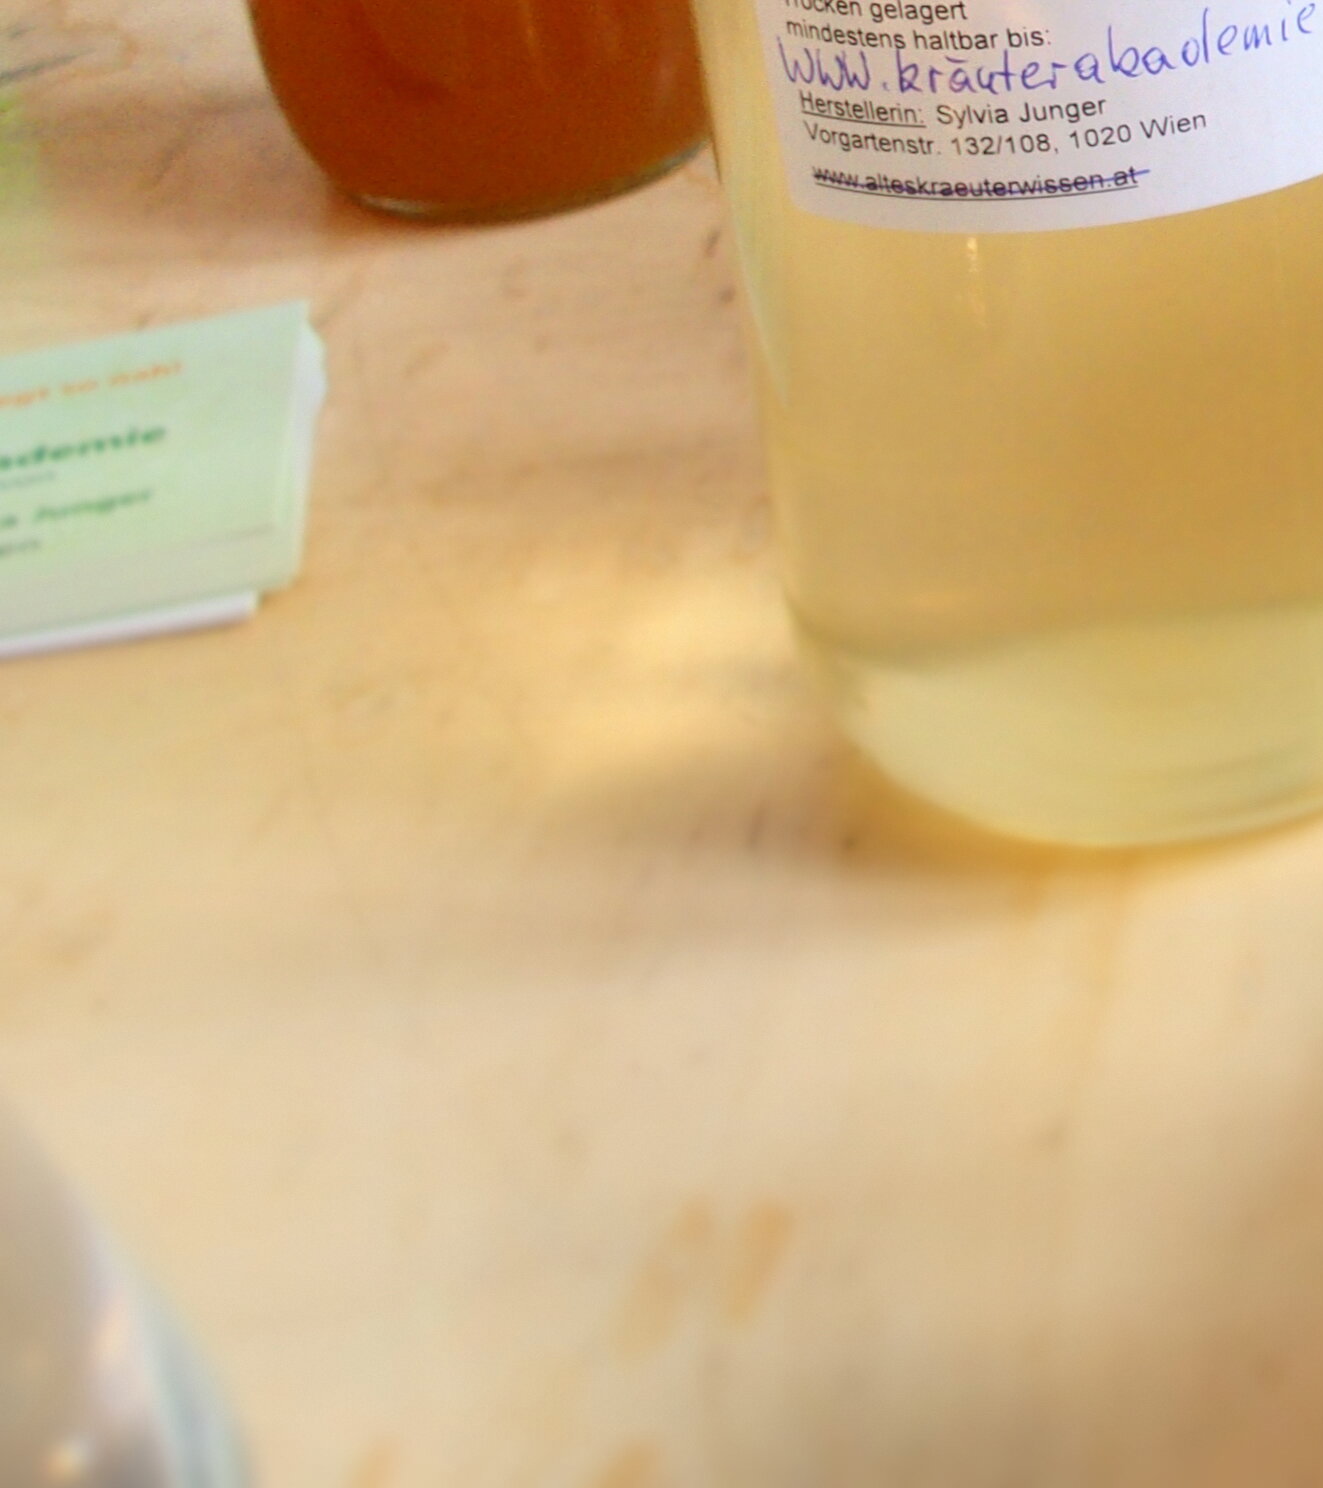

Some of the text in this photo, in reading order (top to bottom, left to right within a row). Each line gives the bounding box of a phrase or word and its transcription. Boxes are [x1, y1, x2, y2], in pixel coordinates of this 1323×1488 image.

[786, 18, 1052, 52] mindestens haltbar bis:
[800, 90, 1107, 130] Herstellerin: Sylvia Junger
[803, 111, 1207, 157] Vorgartenstr. 132/108, 1020 Wien
